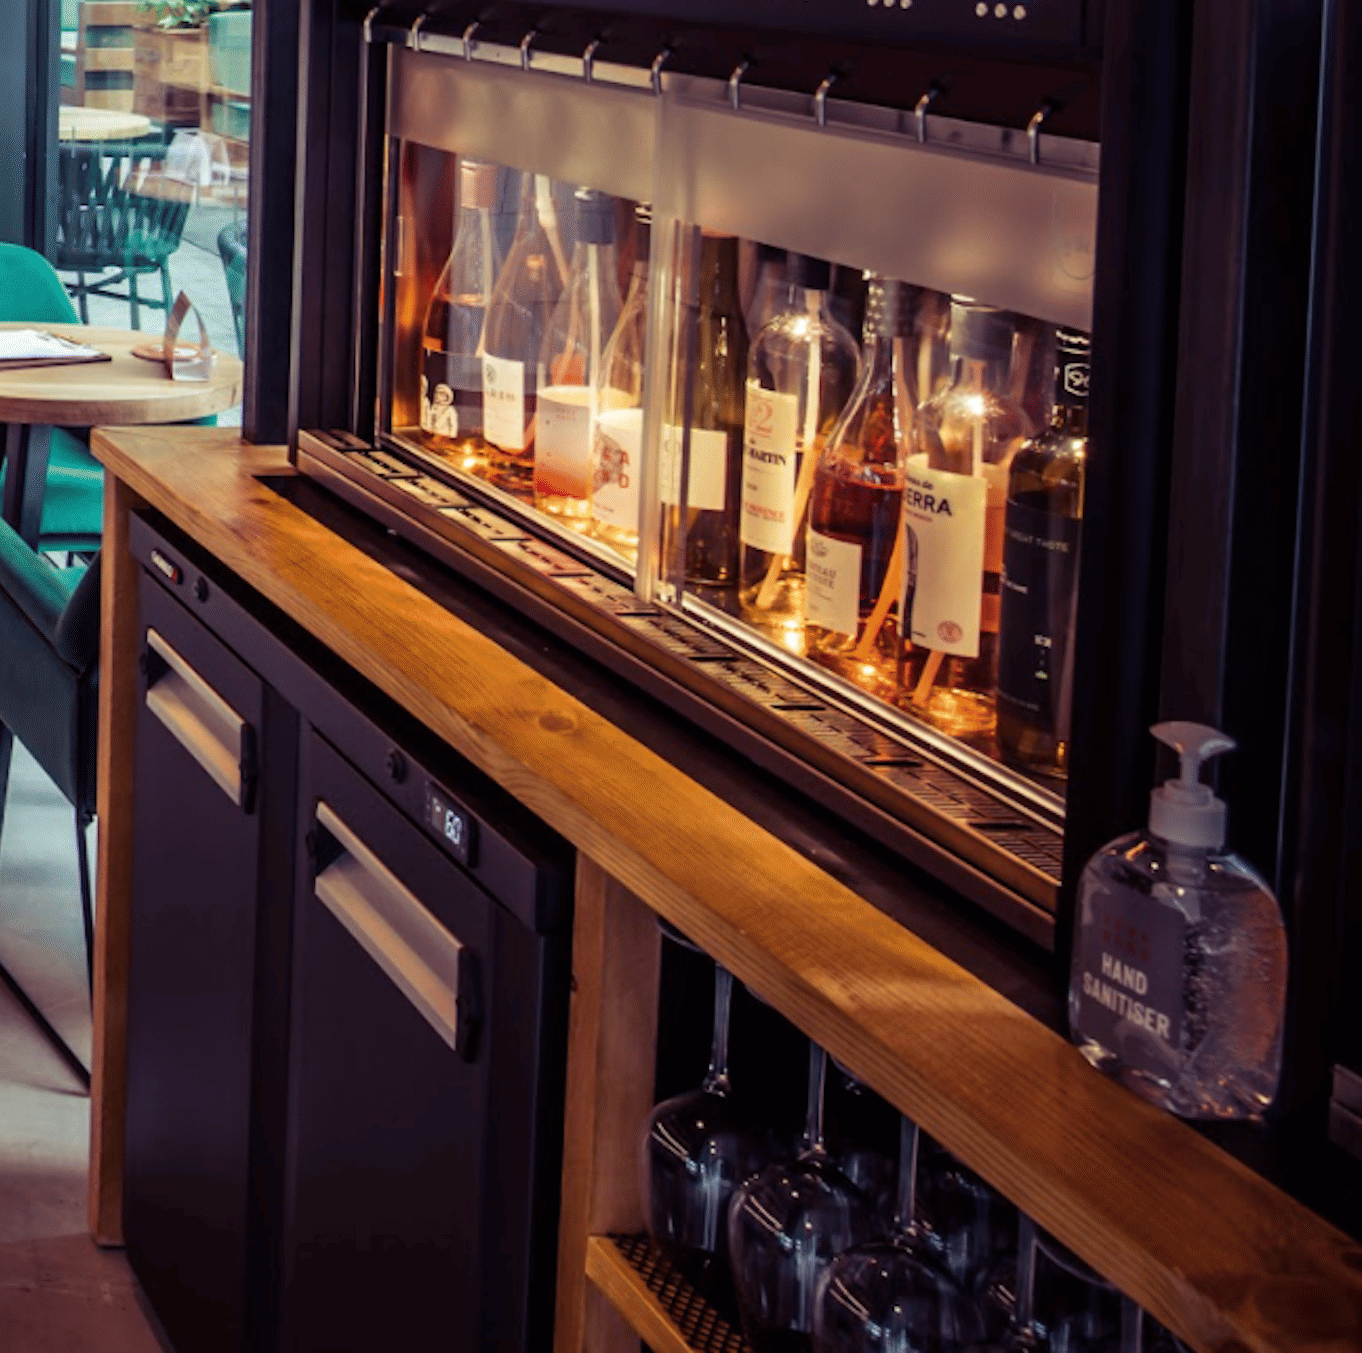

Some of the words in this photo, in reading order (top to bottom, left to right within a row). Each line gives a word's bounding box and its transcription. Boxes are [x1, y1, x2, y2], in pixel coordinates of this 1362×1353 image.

[749, 451, 787, 468] MARTIN
[906, 492, 954, 518] ERRA
[1102, 951, 1148, 997] HAND
[1082, 970, 1171, 1040] SANITISER
